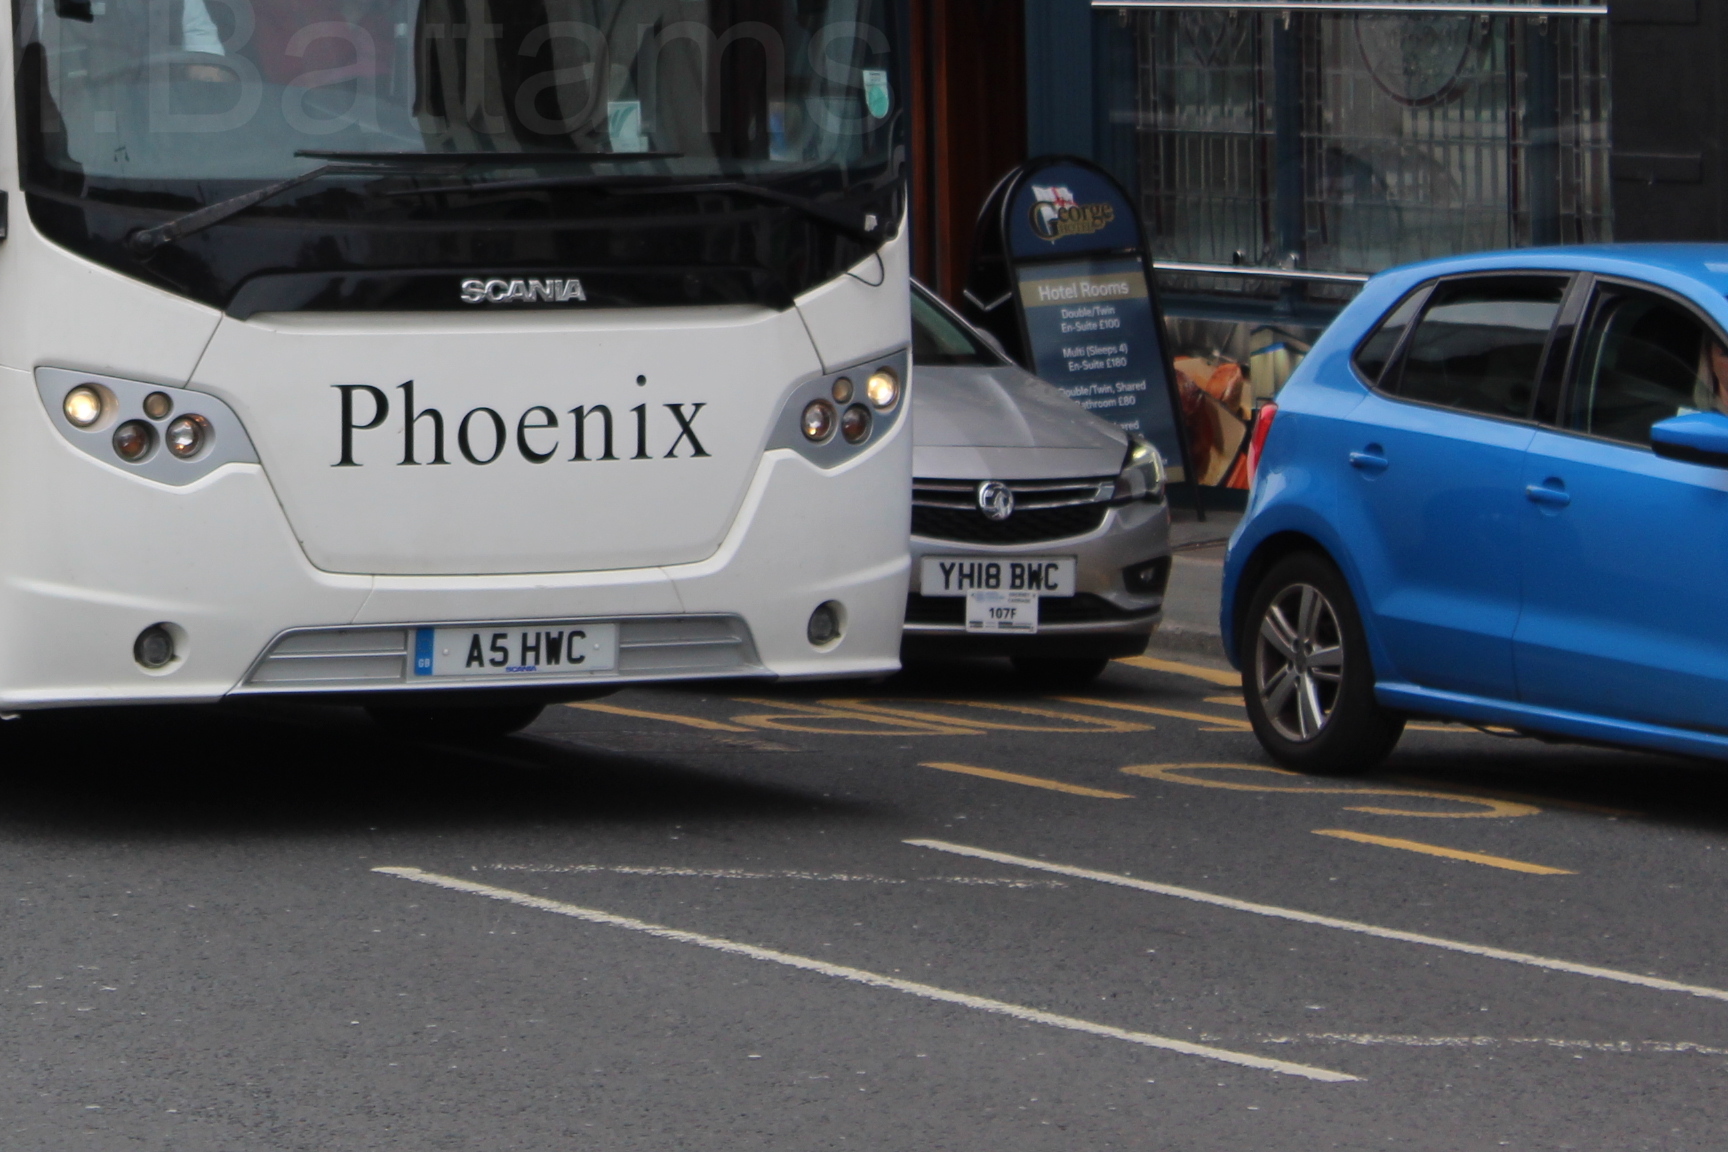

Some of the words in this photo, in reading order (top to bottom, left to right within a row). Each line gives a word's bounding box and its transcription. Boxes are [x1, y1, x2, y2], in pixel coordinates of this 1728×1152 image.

[1028, 200, 1114, 241] George
[460, 276, 587, 304] SCANIA
[1038, 282, 1078, 301] Hotel
[1080, 280, 1129, 299] Rooms
[1061, 305, 1116, 319] Double/Twin
[1061, 320, 1098, 334] En-Suite
[1098, 318, 1120, 331] £100
[1062, 347, 1085, 359] Multi
[1087, 344, 1119, 359] (Sleeps
[1119, 343, 1129, 356] 4)
[1068, 359, 1105, 372] En-Suite
[1106, 357, 1127, 369] £180
[1115, 380, 1147, 393] Shared
[1118, 396, 1136, 407] £80
[329, 374, 712, 467] Phoenix
[939, 562, 1002, 590] YH18
[1009, 562, 1059, 590] BWC
[988, 607, 1017, 620] 107F
[465, 632, 509, 668] A5
[521, 630, 586, 666] HWC
[418, 659, 430, 668] GB
[505, 665, 537, 673] SCANIA
